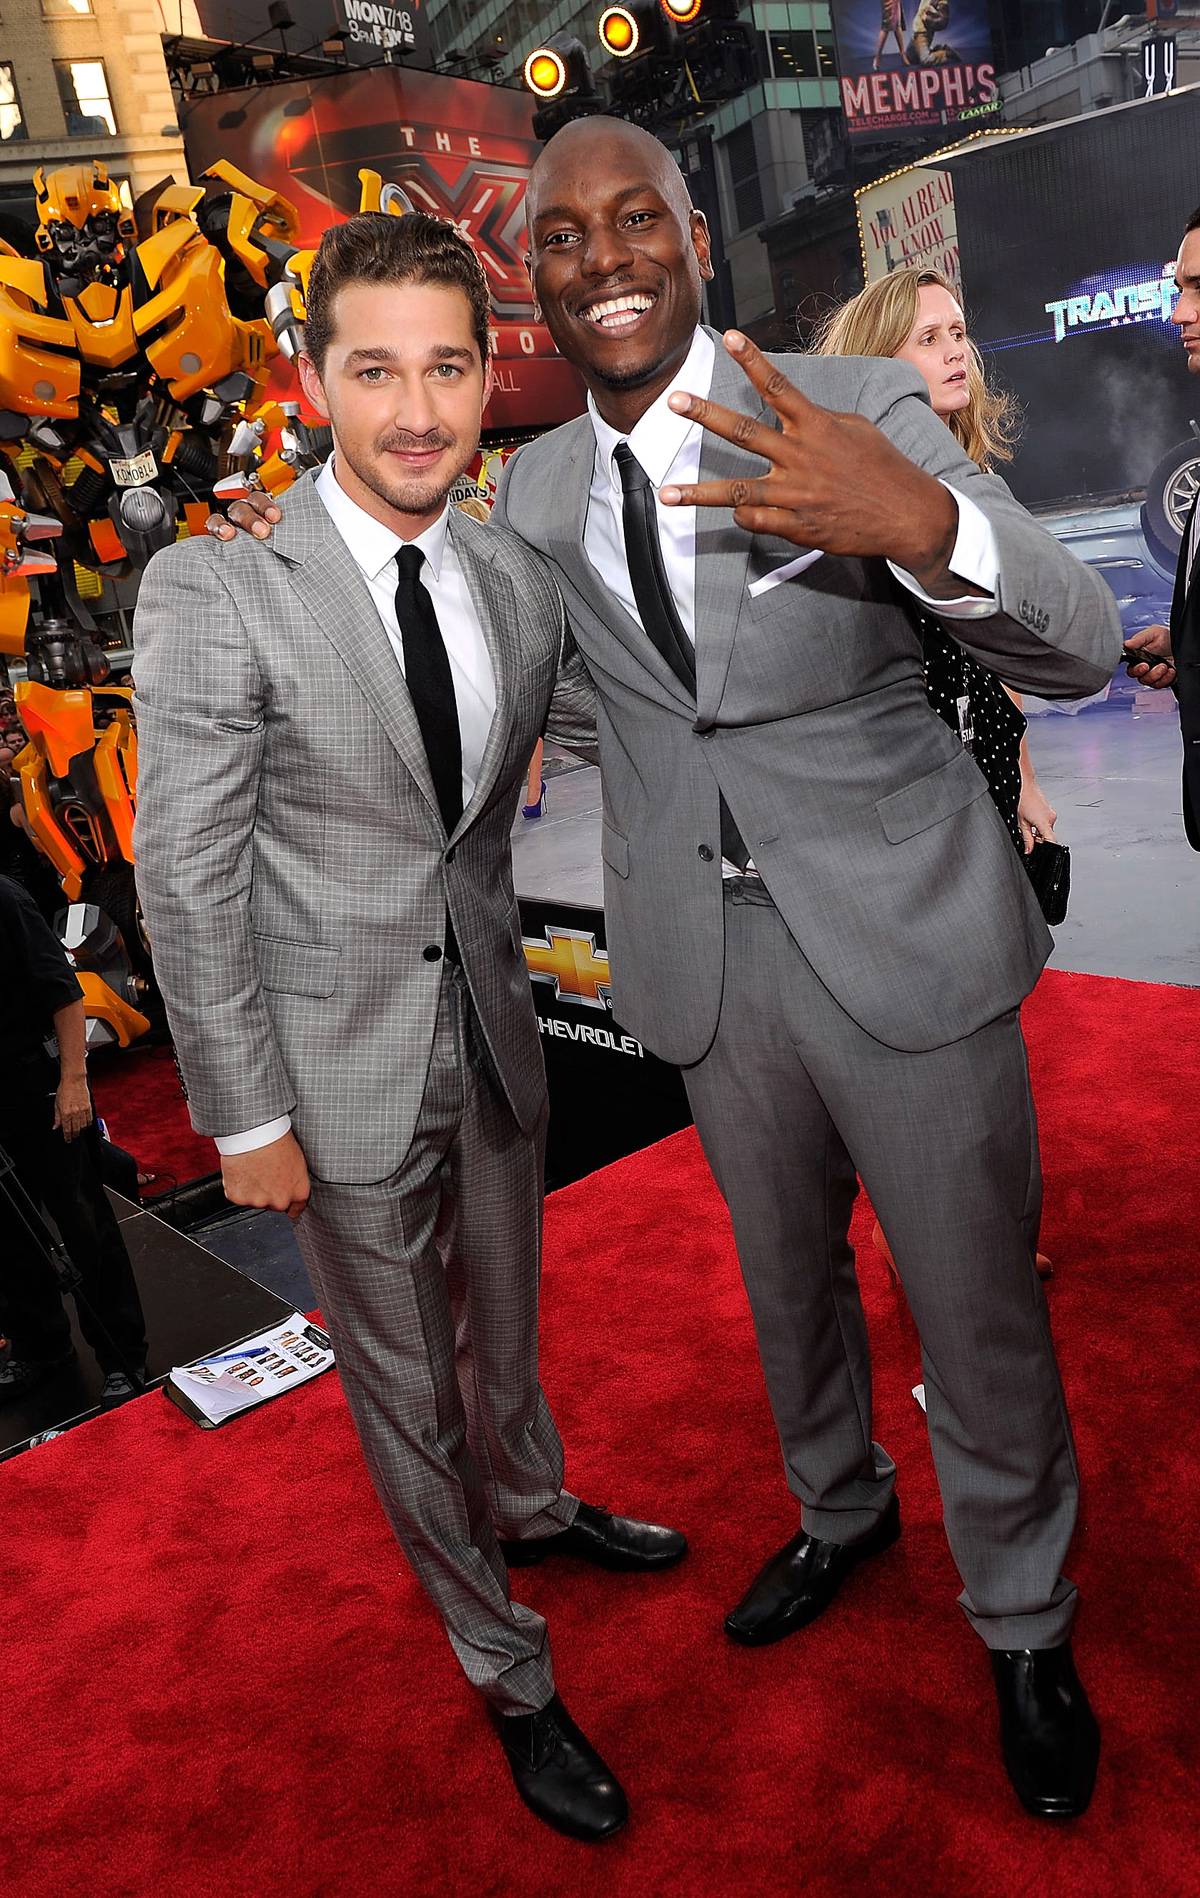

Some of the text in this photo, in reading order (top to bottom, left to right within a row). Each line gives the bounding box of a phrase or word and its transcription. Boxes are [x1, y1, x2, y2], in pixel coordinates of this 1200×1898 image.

[960, 102, 999, 119] LAMAR
[400, 127, 481, 156] THE
[492, 369, 521, 392] ALL
[535, 1016, 644, 1058] HEVROLET
